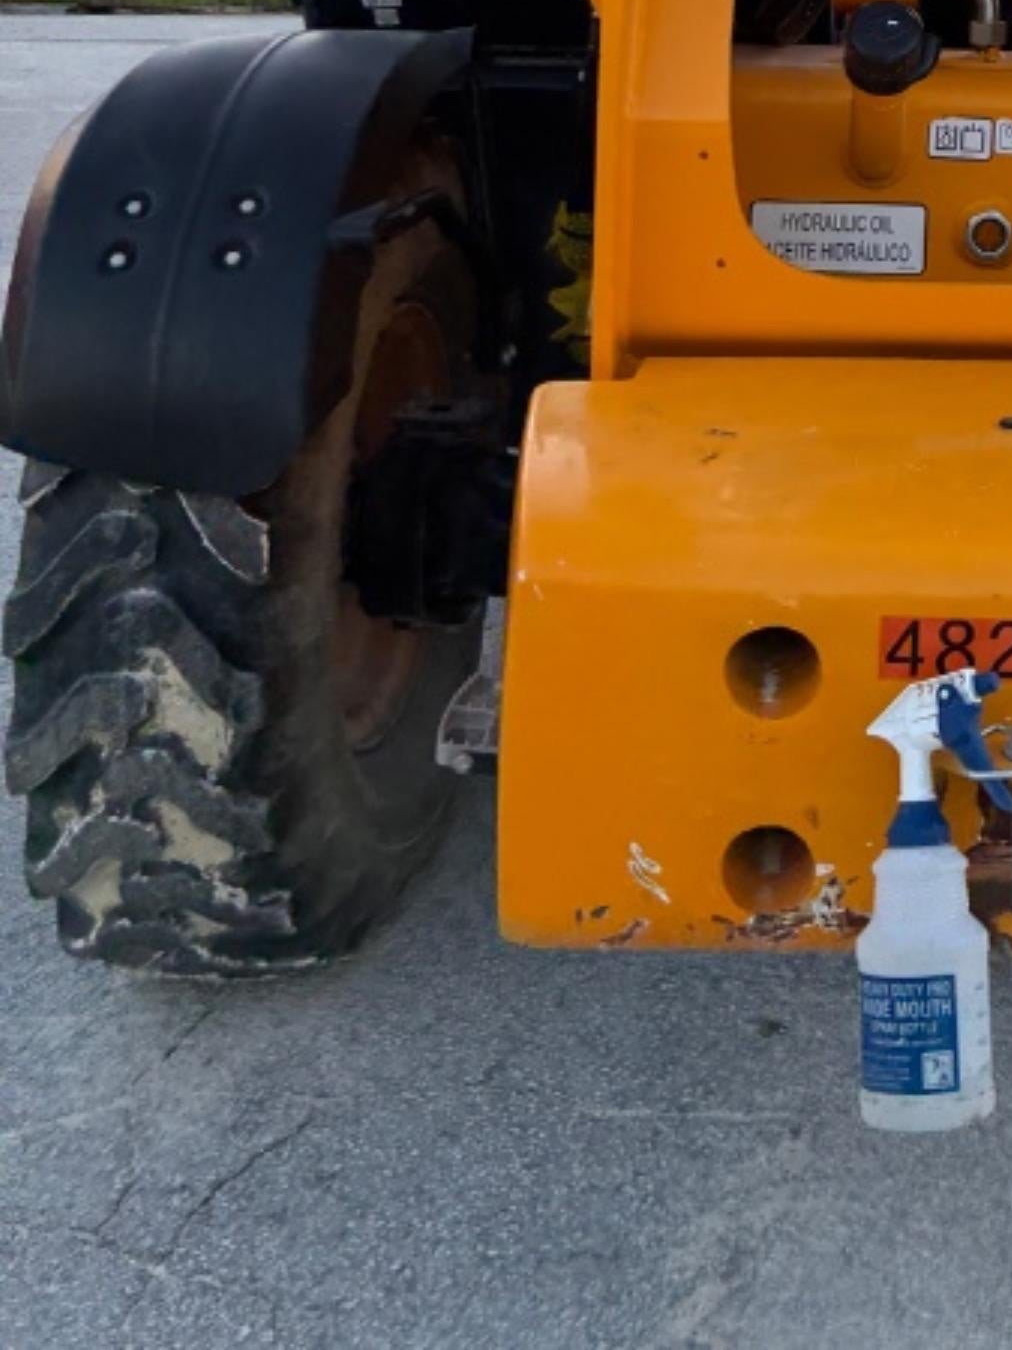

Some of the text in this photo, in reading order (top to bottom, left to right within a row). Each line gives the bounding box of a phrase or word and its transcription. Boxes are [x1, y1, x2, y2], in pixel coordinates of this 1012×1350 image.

[782, 212, 895, 235] HYDRAULIC OIL
[820, 239, 911, 263] HIDRÁULICO
[894, 999, 952, 1018] MOUTH
